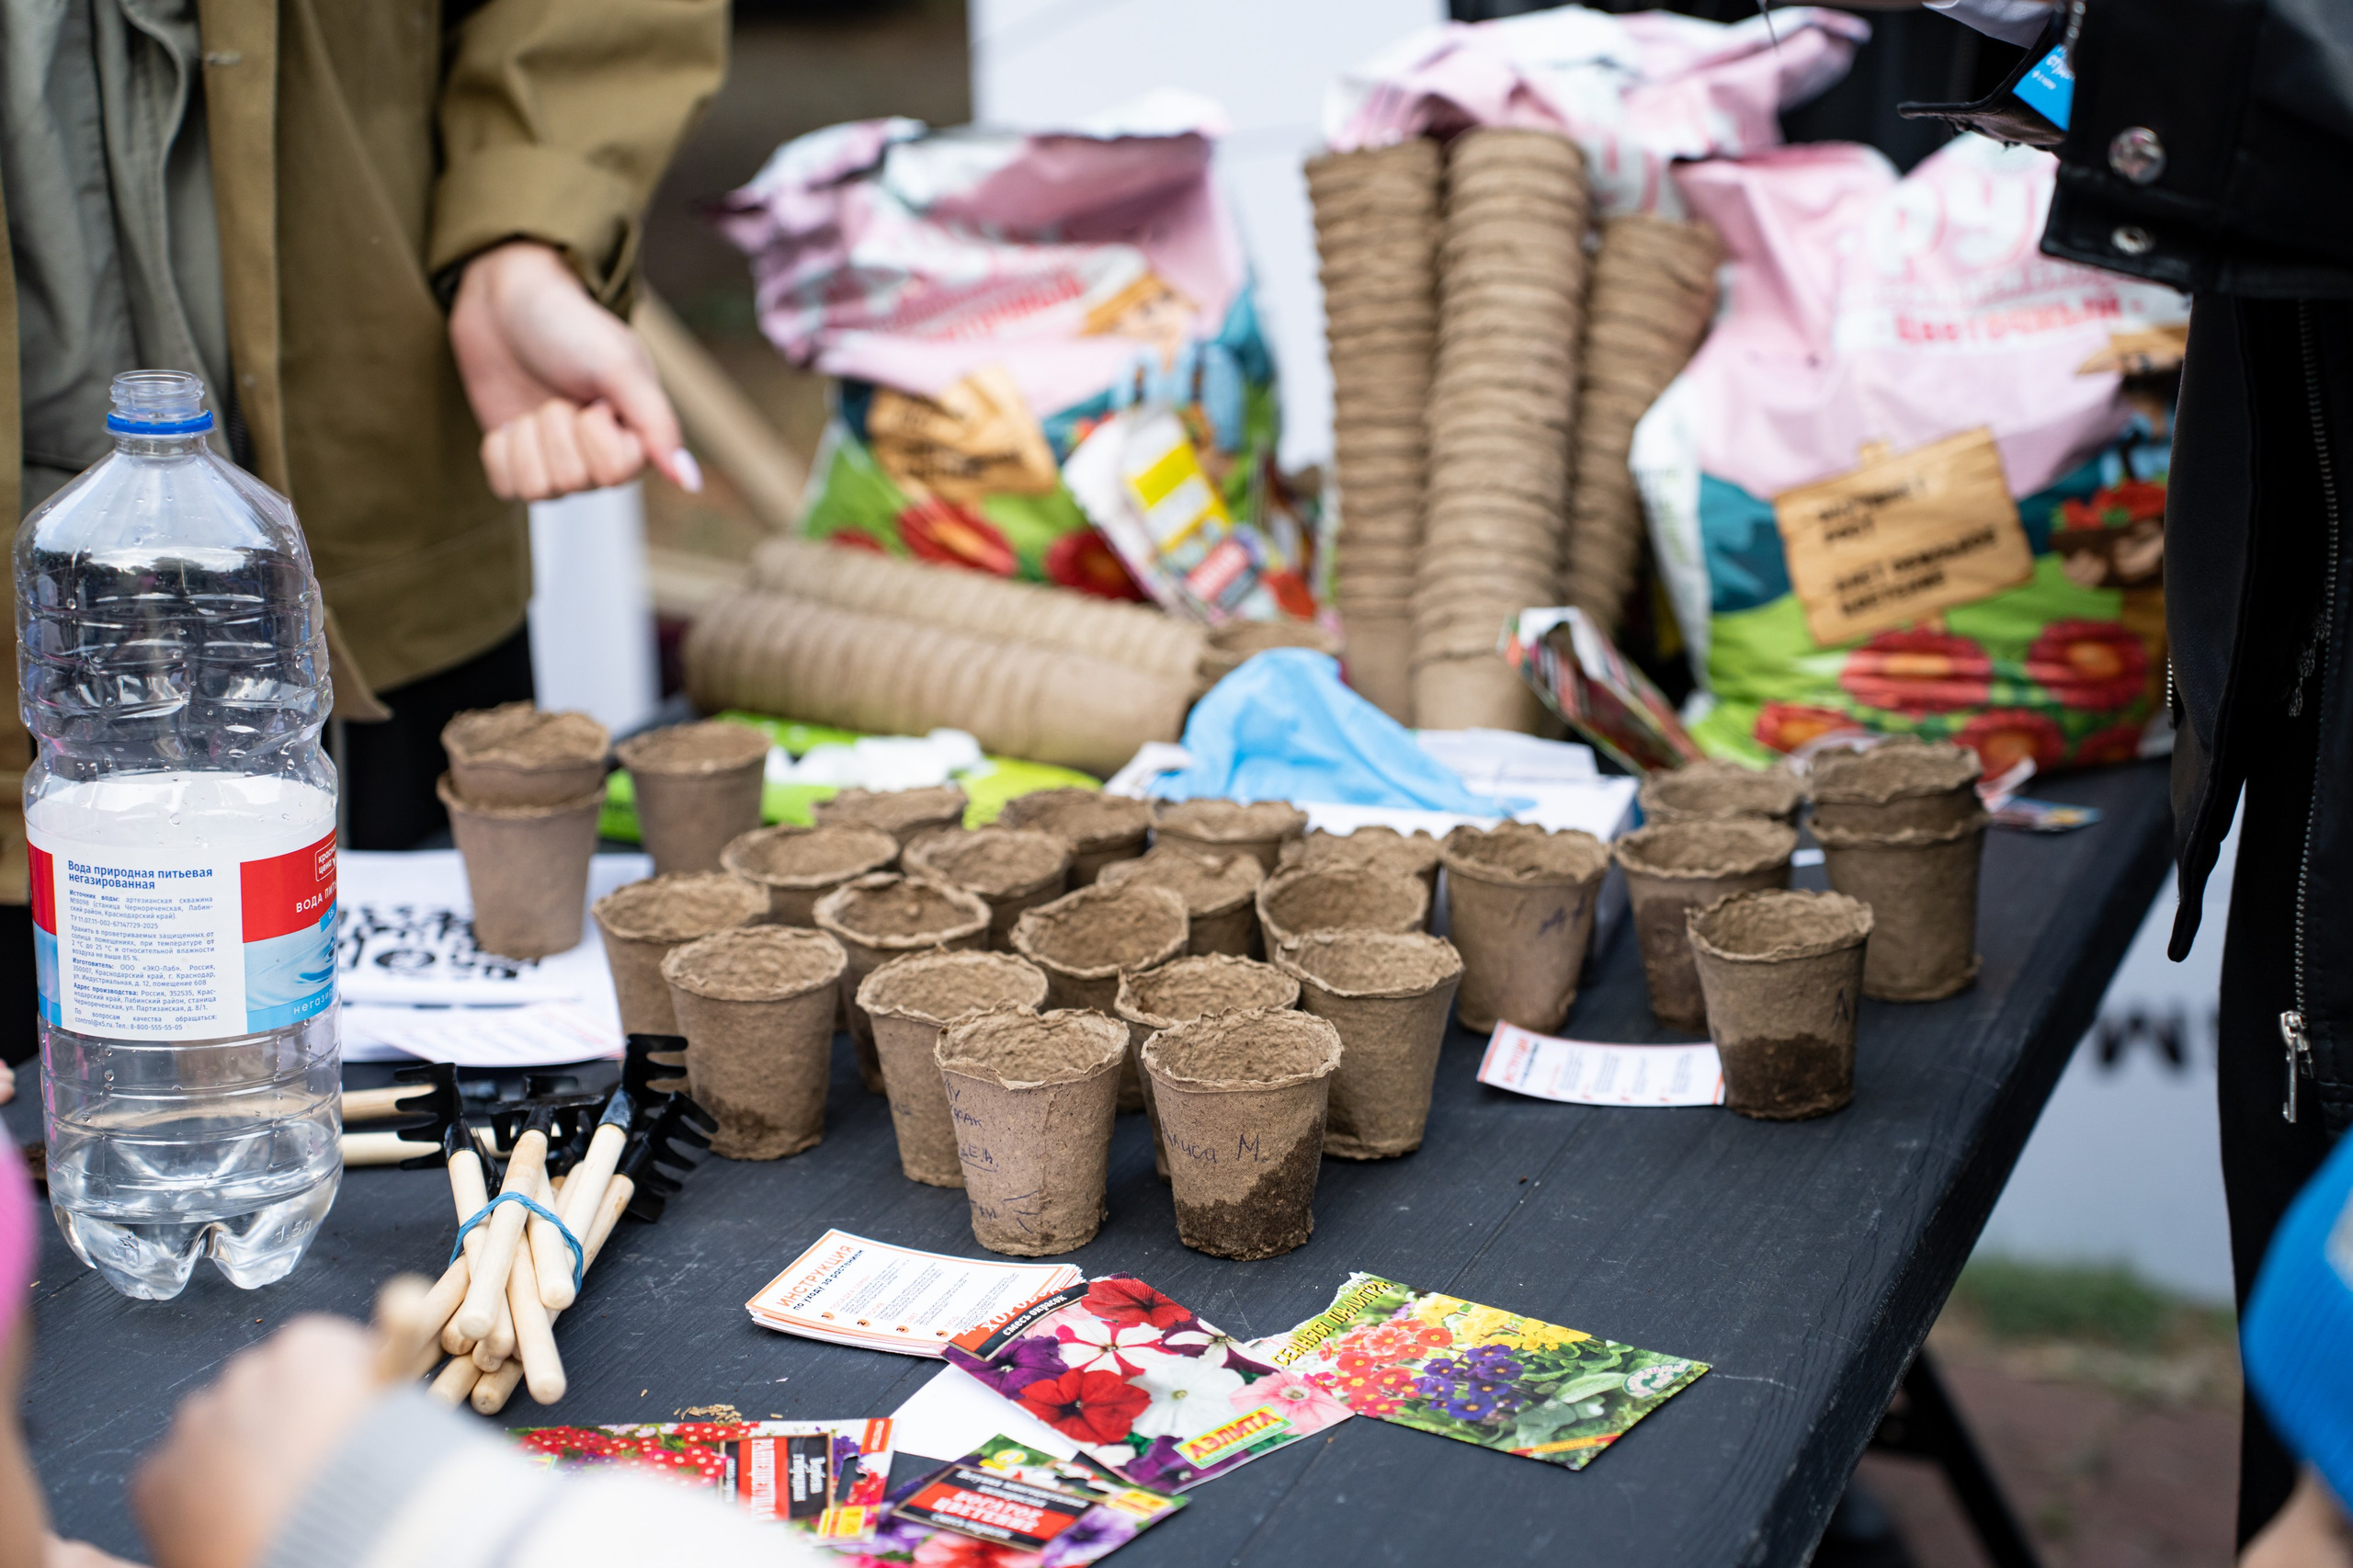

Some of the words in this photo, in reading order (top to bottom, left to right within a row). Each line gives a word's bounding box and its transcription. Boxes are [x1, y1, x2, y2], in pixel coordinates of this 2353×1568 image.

[68, 860, 91, 874] Вода
[94, 866, 154, 879] природная
[158, 869, 212, 879] питьевая
[69, 873, 155, 889] негазированная
[69, 889, 96, 899] Источник
[178, 896, 213, 904] скважина
[296, 893, 324, 914] ВОДА
[93, 900, 120, 910] (станица
[125, 903, 184, 913] Чернореченская,
[84, 908, 104, 916] район,
[105, 910, 154, 919] Краснодарский
[156, 913, 177, 921] край).
[71, 925, 95, 935] Хранить
[101, 930, 156, 939] проветриваемых
[72, 933, 91, 941] солнца
[94, 937, 136, 947] помещениях,
[157, 939, 202, 948] температуре
[72, 948, 95, 958] воздуха
[73, 957, 115, 969] Изготовитель:
[189, 963, 216, 971] Россия,
[82, 974, 134, 987] Индустриальная,
[96, 969, 144, 979] Краснодарский
[176, 971, 216, 980] Краснодар,
[74, 982, 90, 991] Адрес
[92, 986, 139, 995] производства:
[197, 989, 216, 997] Крас-
[74, 991, 104, 1000] нодарский
[188, 996, 217, 1005] станица
[74, 997, 125, 1011] Чернореченская,
[136, 1005, 187, 1013] Партизанская,
[92, 1012, 120, 1020] вопросам
[175, 1015, 218, 1023] обращаться:
[115, 1021, 129, 1029] Тел.:
[1161, 1117, 1218, 1164] Алиса
[1236, 1133, 1268, 1163] М.
[776, 1244, 855, 1307] ИНСТРУКЦИЯ
[793, 1301, 804, 1311] по
[803, 1285, 826, 1303] уходу
[821, 1278, 833, 1286] за
[830, 1249, 865, 1279] растением
[1003, 1314, 1032, 1336] смесь
[1029, 1294, 1067, 1316] окрасок
[1271, 1321, 1336, 1368] СЕННЯЯ
[1324, 1279, 1394, 1325] ПАЛИТРА
[1189, 1410, 1281, 1460] АЭЛИТА
